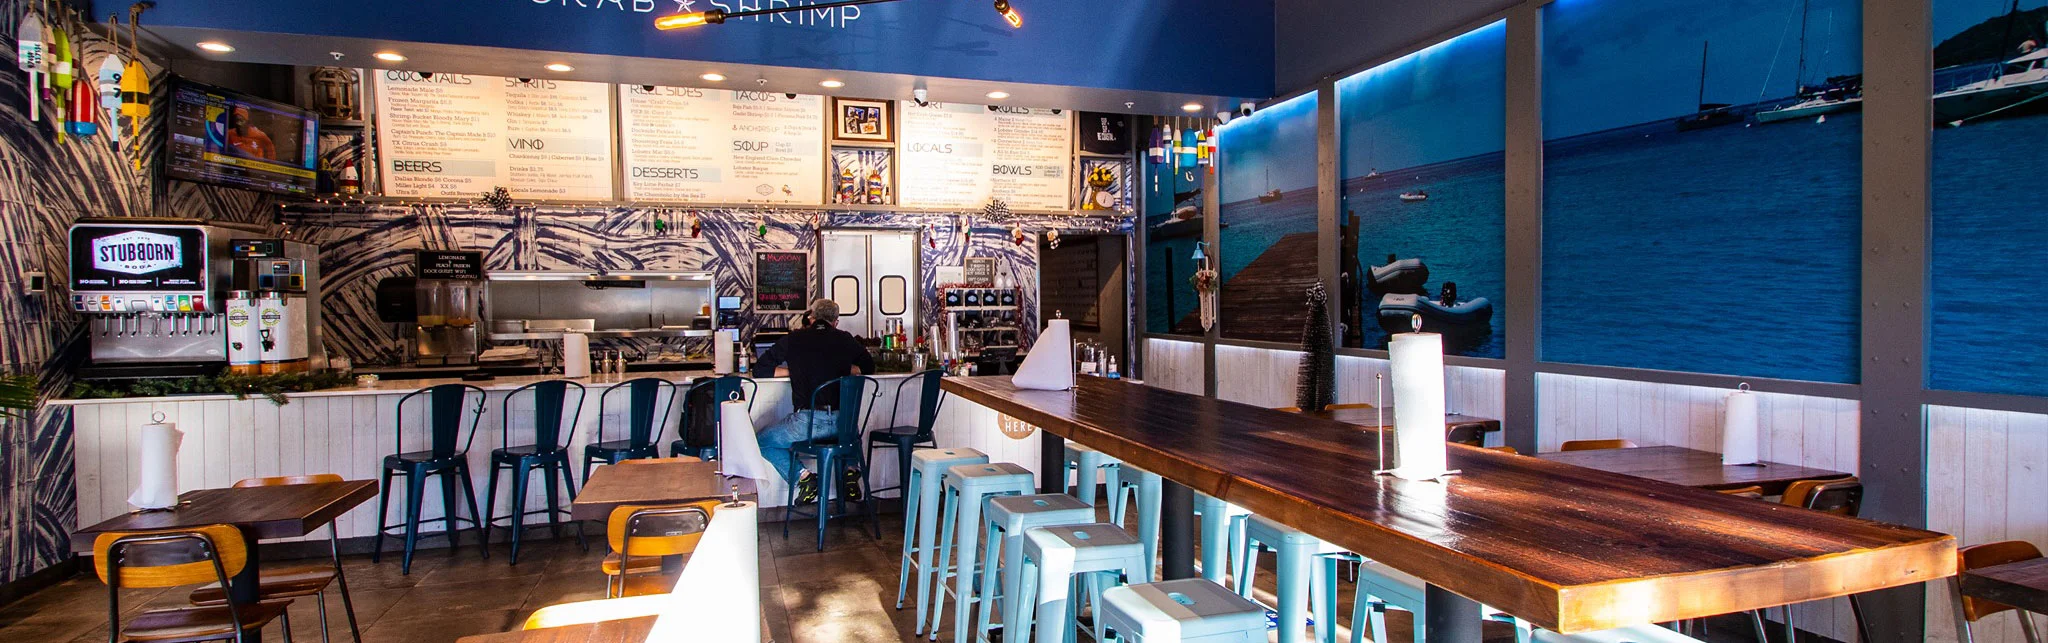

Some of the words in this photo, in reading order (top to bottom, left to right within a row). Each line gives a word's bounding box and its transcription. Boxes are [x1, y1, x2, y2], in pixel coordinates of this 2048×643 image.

[530, 0, 655, 13] AB
[709, 0, 861, 28] SHRIMP
[505, 77, 557, 89] SPIRITS
[666, 87, 703, 98] SIDES
[735, 90, 776, 102] TACOS
[909, 100, 943, 109] SRT
[994, 105, 1029, 114] ROLLS
[508, 138, 544, 150] VINO
[733, 140, 768, 151] SOUP
[907, 142, 952, 154] LOCALS
[213, 155, 236, 164] COMING
[394, 160, 442, 172] BEERS
[992, 164, 1032, 175] BOWLS
[632, 167, 698, 179] DESSERTS
[100, 243, 175, 262] STUBBORN
[1005, 422, 1033, 432] HERE
